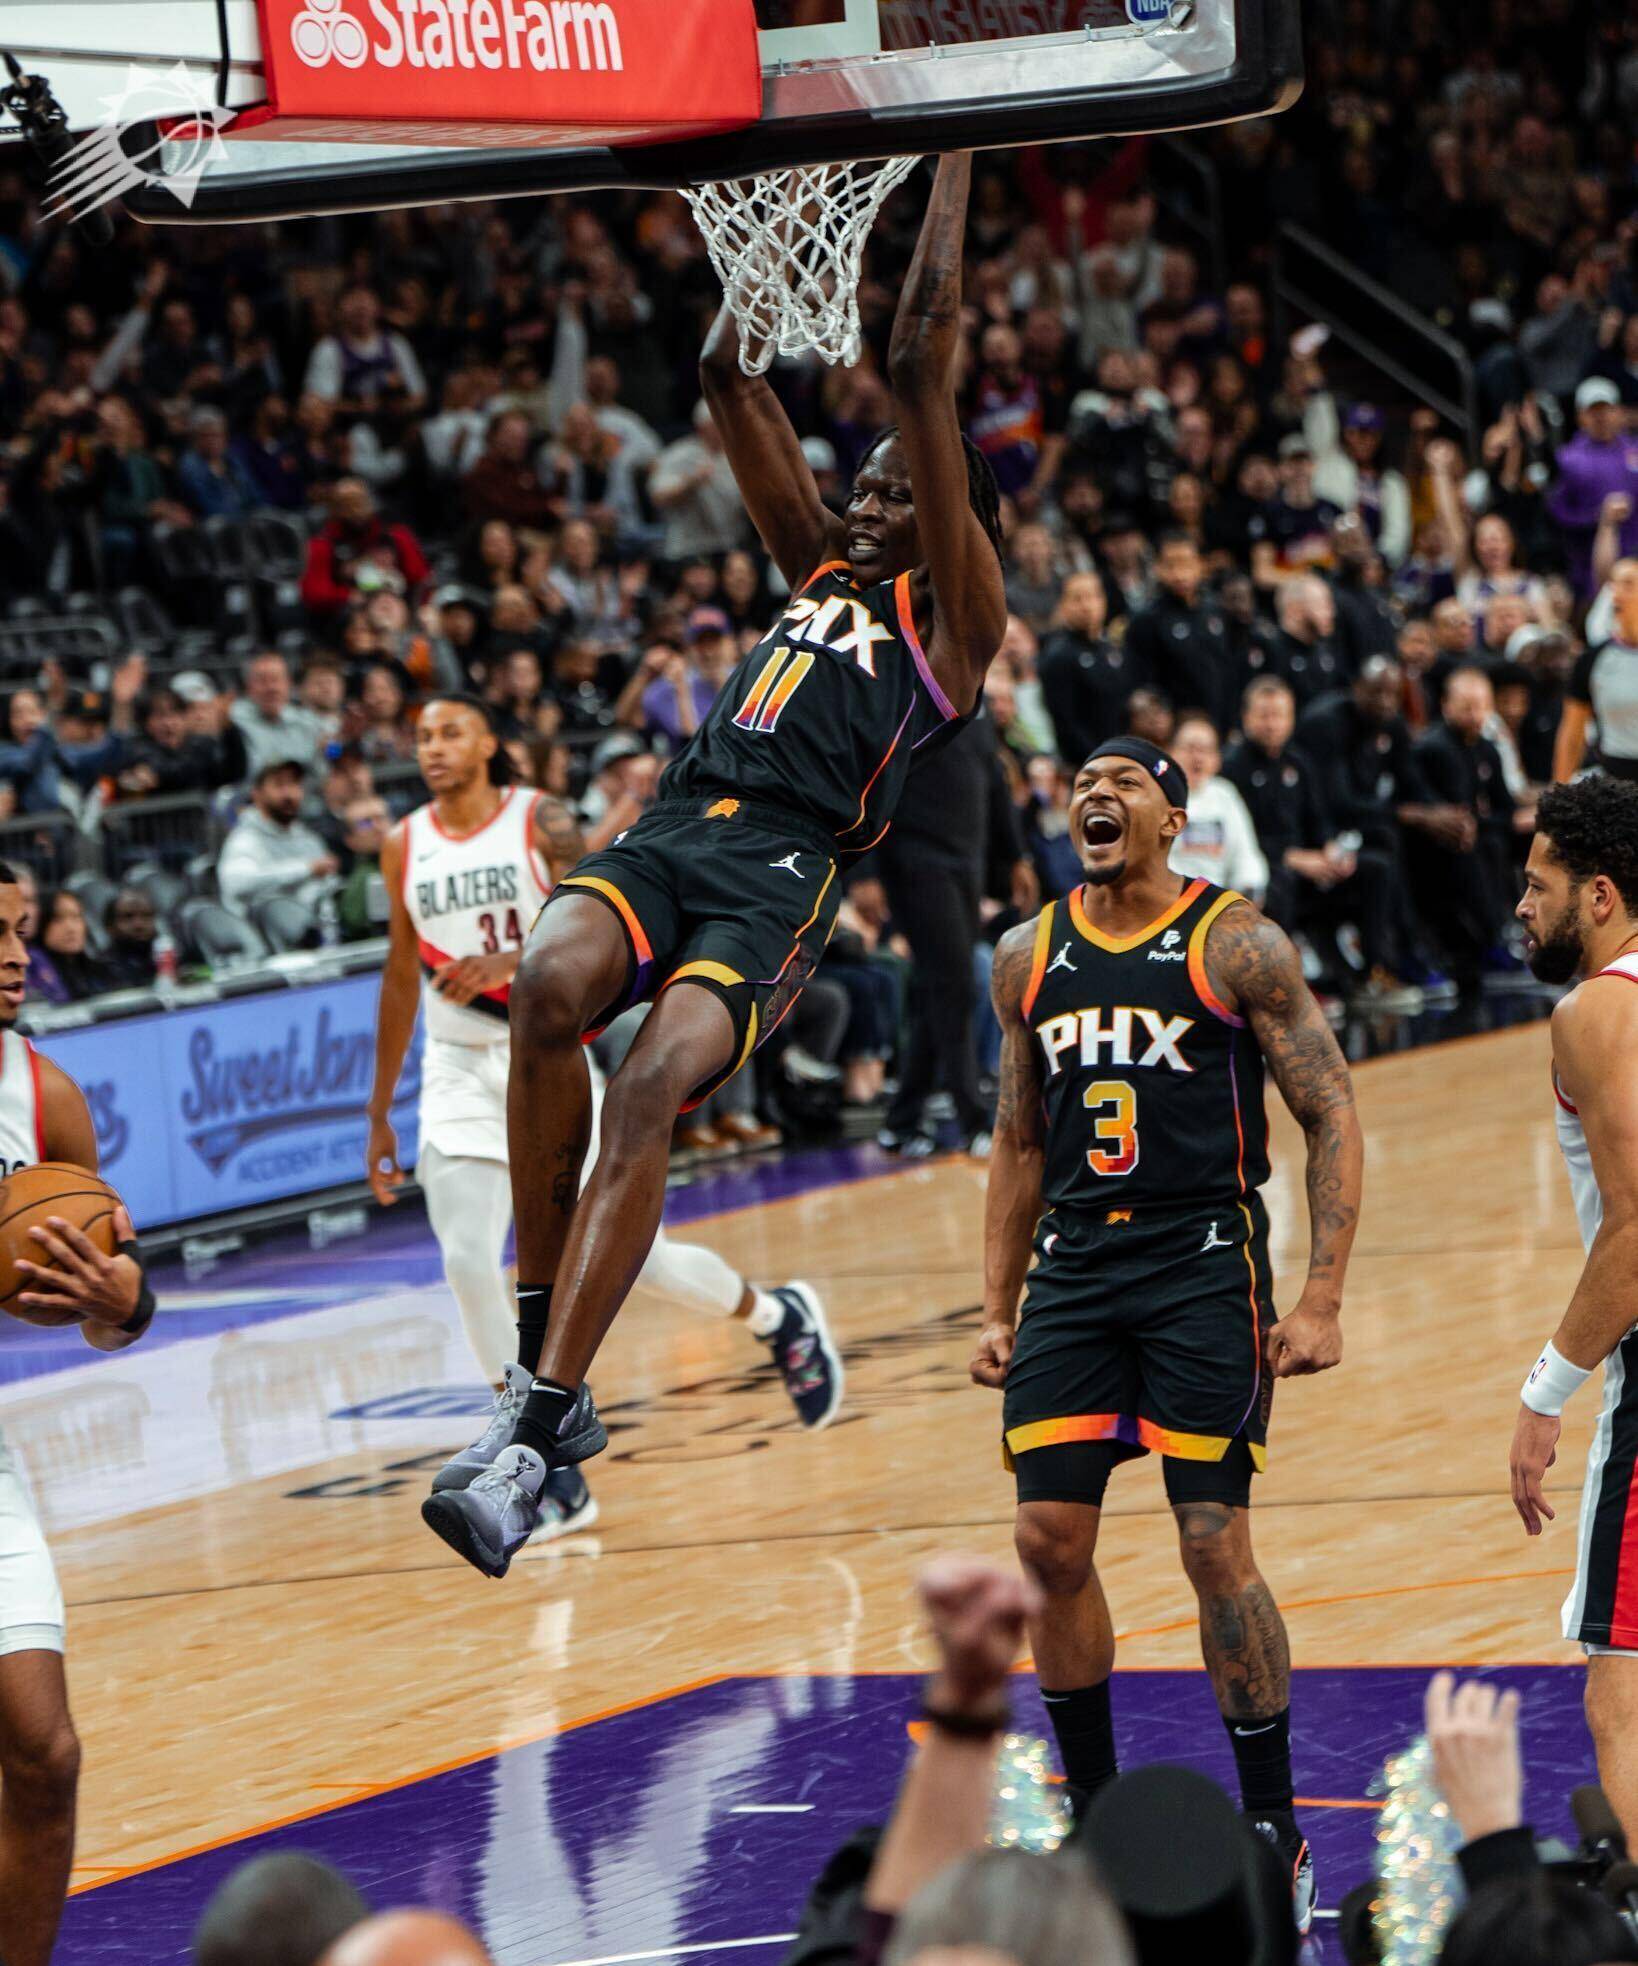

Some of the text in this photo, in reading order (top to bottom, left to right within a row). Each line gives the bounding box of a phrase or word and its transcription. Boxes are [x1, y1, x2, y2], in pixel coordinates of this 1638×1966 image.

[731, 646, 816, 734] 11
[416, 864, 518, 919] BLAZERS
[479, 908, 524, 955] 34
[1147, 950, 1187, 962] PayPal
[1036, 1006, 1197, 1076] PHX
[1083, 1080, 1139, 1176] 3
